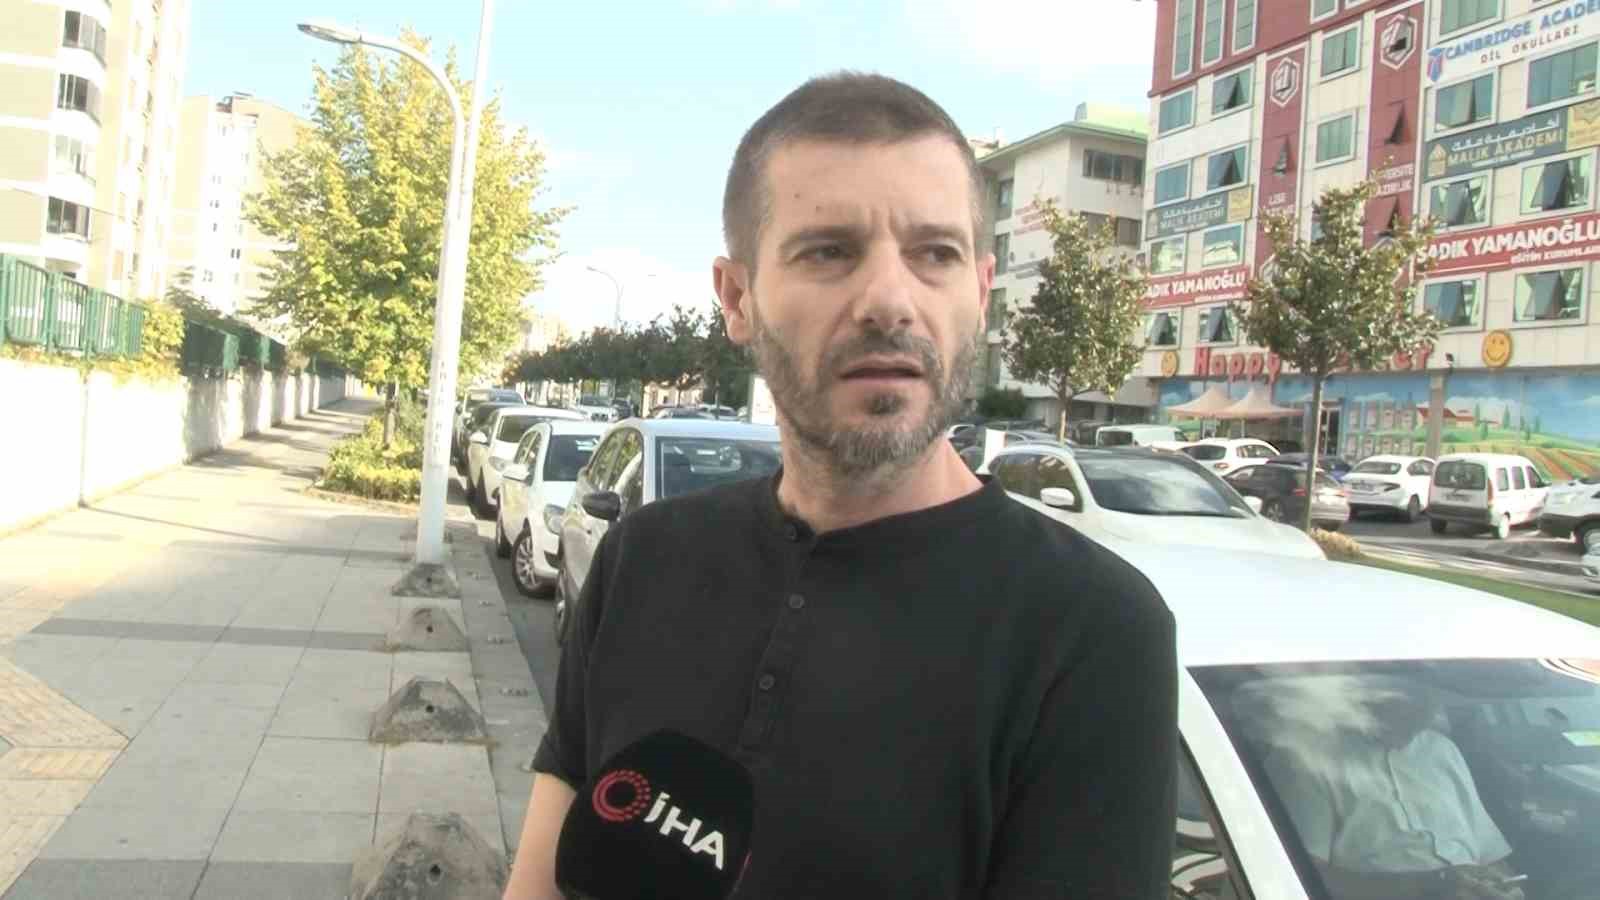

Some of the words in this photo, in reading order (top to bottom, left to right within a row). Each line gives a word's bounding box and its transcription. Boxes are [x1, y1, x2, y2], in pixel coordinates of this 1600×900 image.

[1445, 22, 1532, 60] CAMBRIDGE
[1540, 0, 1600, 31] ACADE
[1512, 25, 1579, 54] OKULLARI
